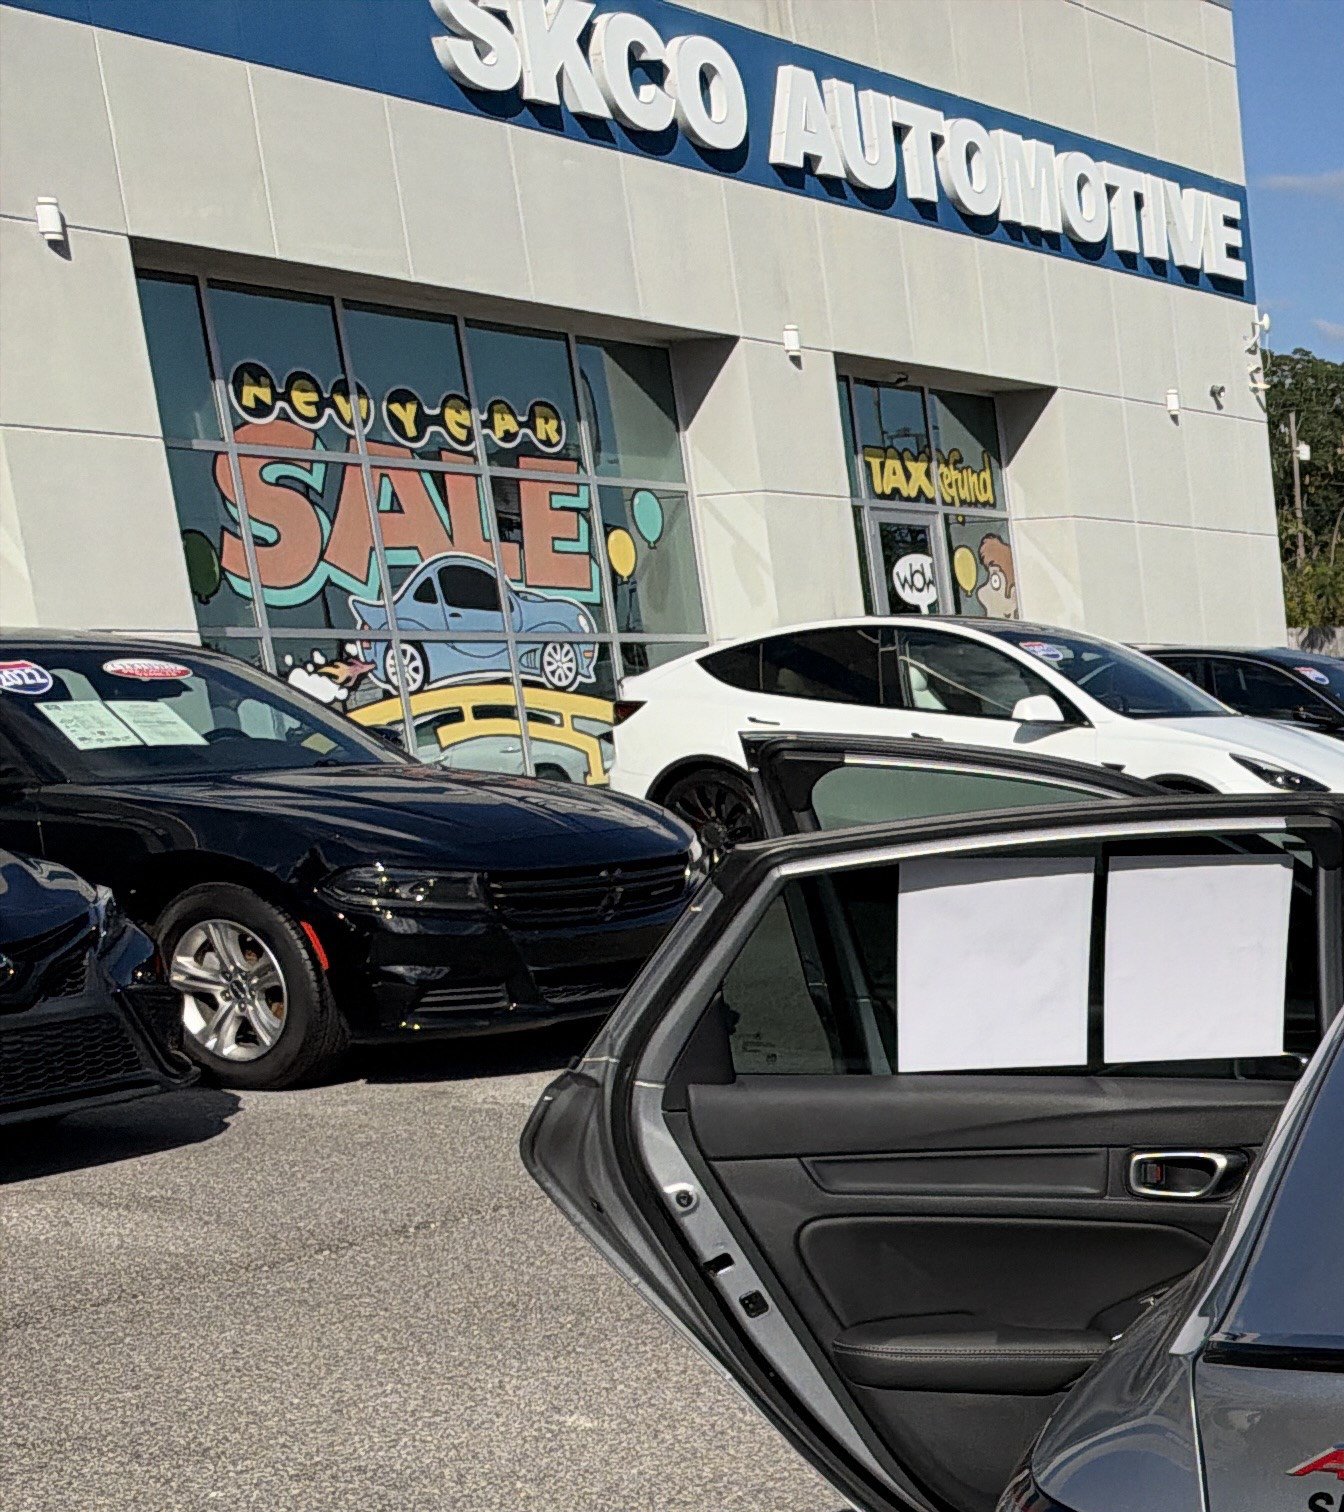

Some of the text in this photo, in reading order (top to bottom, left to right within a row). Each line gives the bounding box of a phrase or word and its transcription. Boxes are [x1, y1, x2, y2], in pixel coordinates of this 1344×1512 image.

[432, 0, 1248, 281] SKCO AUTOMOTIVE
[214, 419, 596, 594] SALE
[863, 447, 936, 499] TAX
